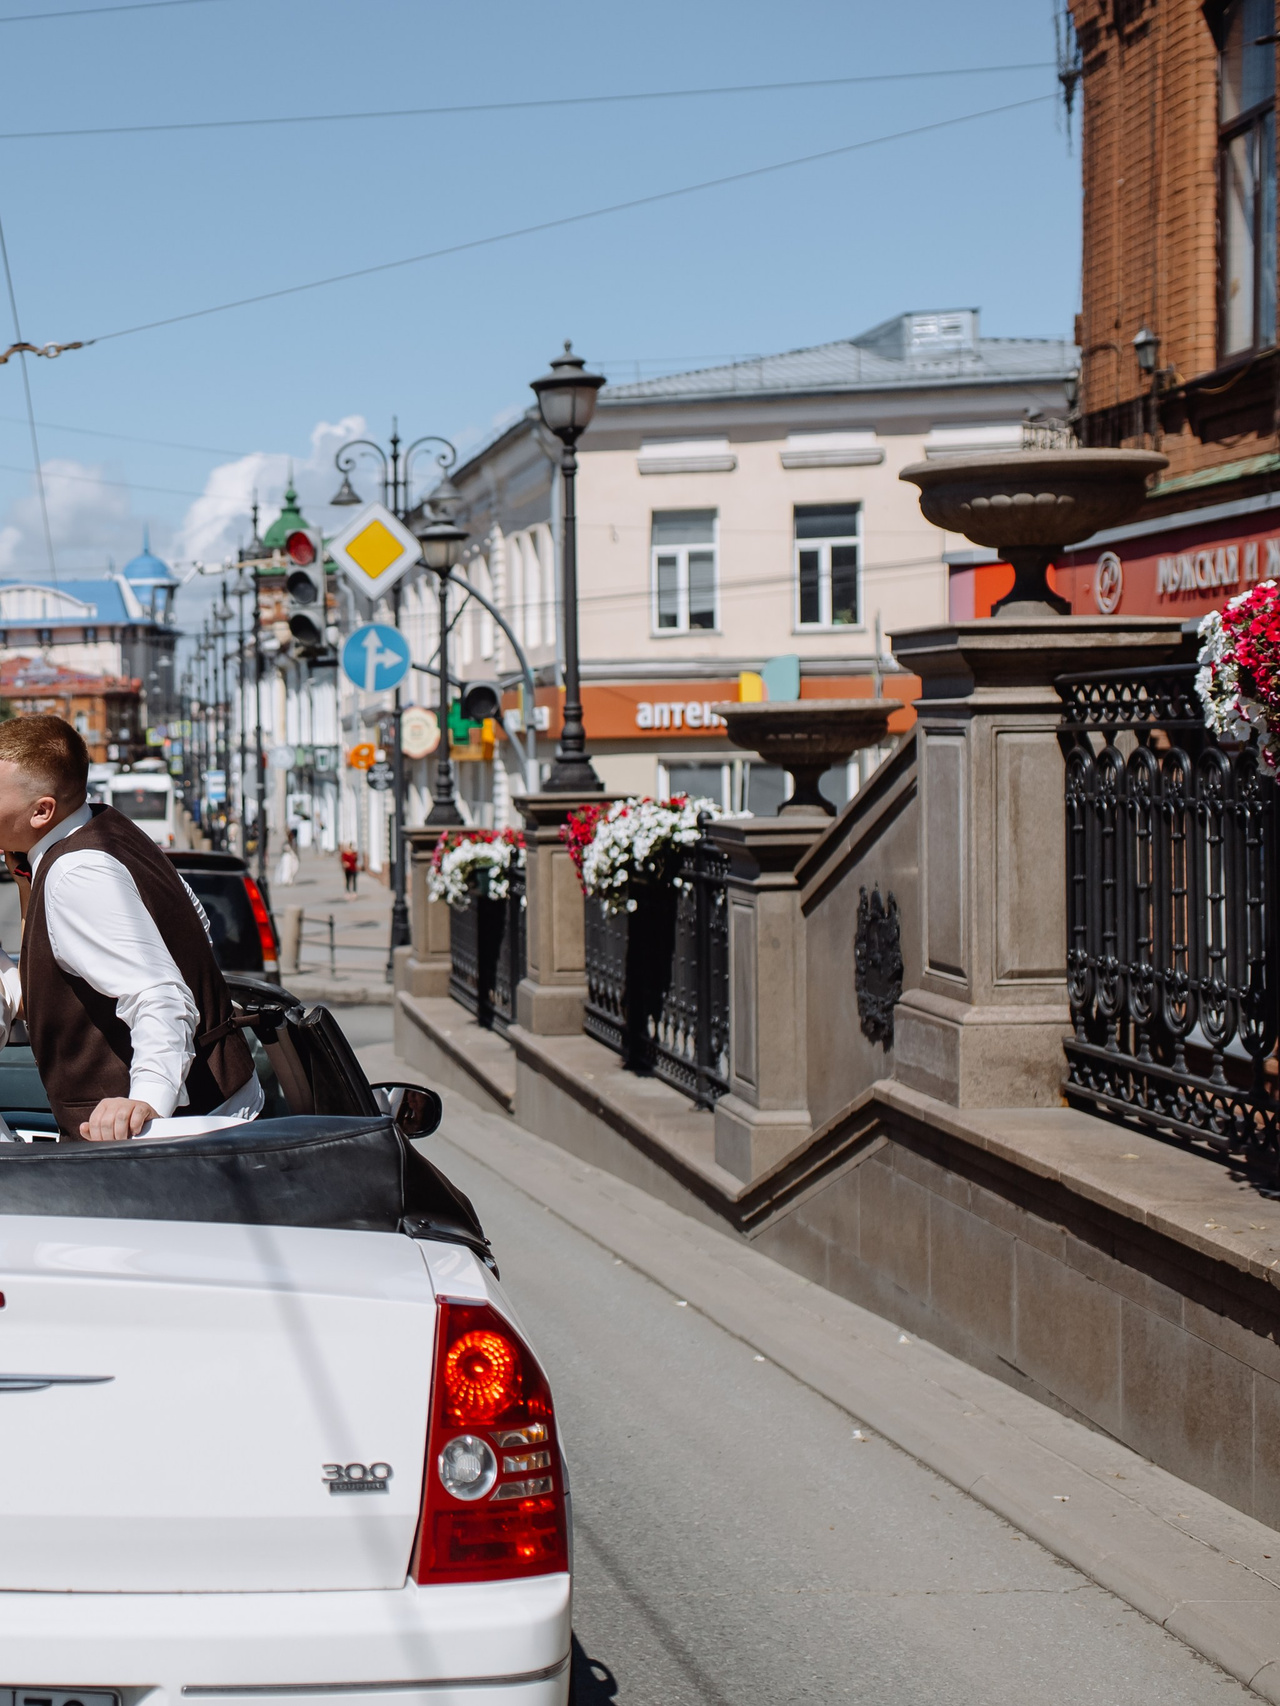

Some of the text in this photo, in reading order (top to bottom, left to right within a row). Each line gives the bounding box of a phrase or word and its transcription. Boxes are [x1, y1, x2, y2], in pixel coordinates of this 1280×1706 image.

[1157, 545, 1239, 594] МУЖСКАЯ
[1245, 542, 1259, 580] И
[321, 1462, 394, 1483] 300
